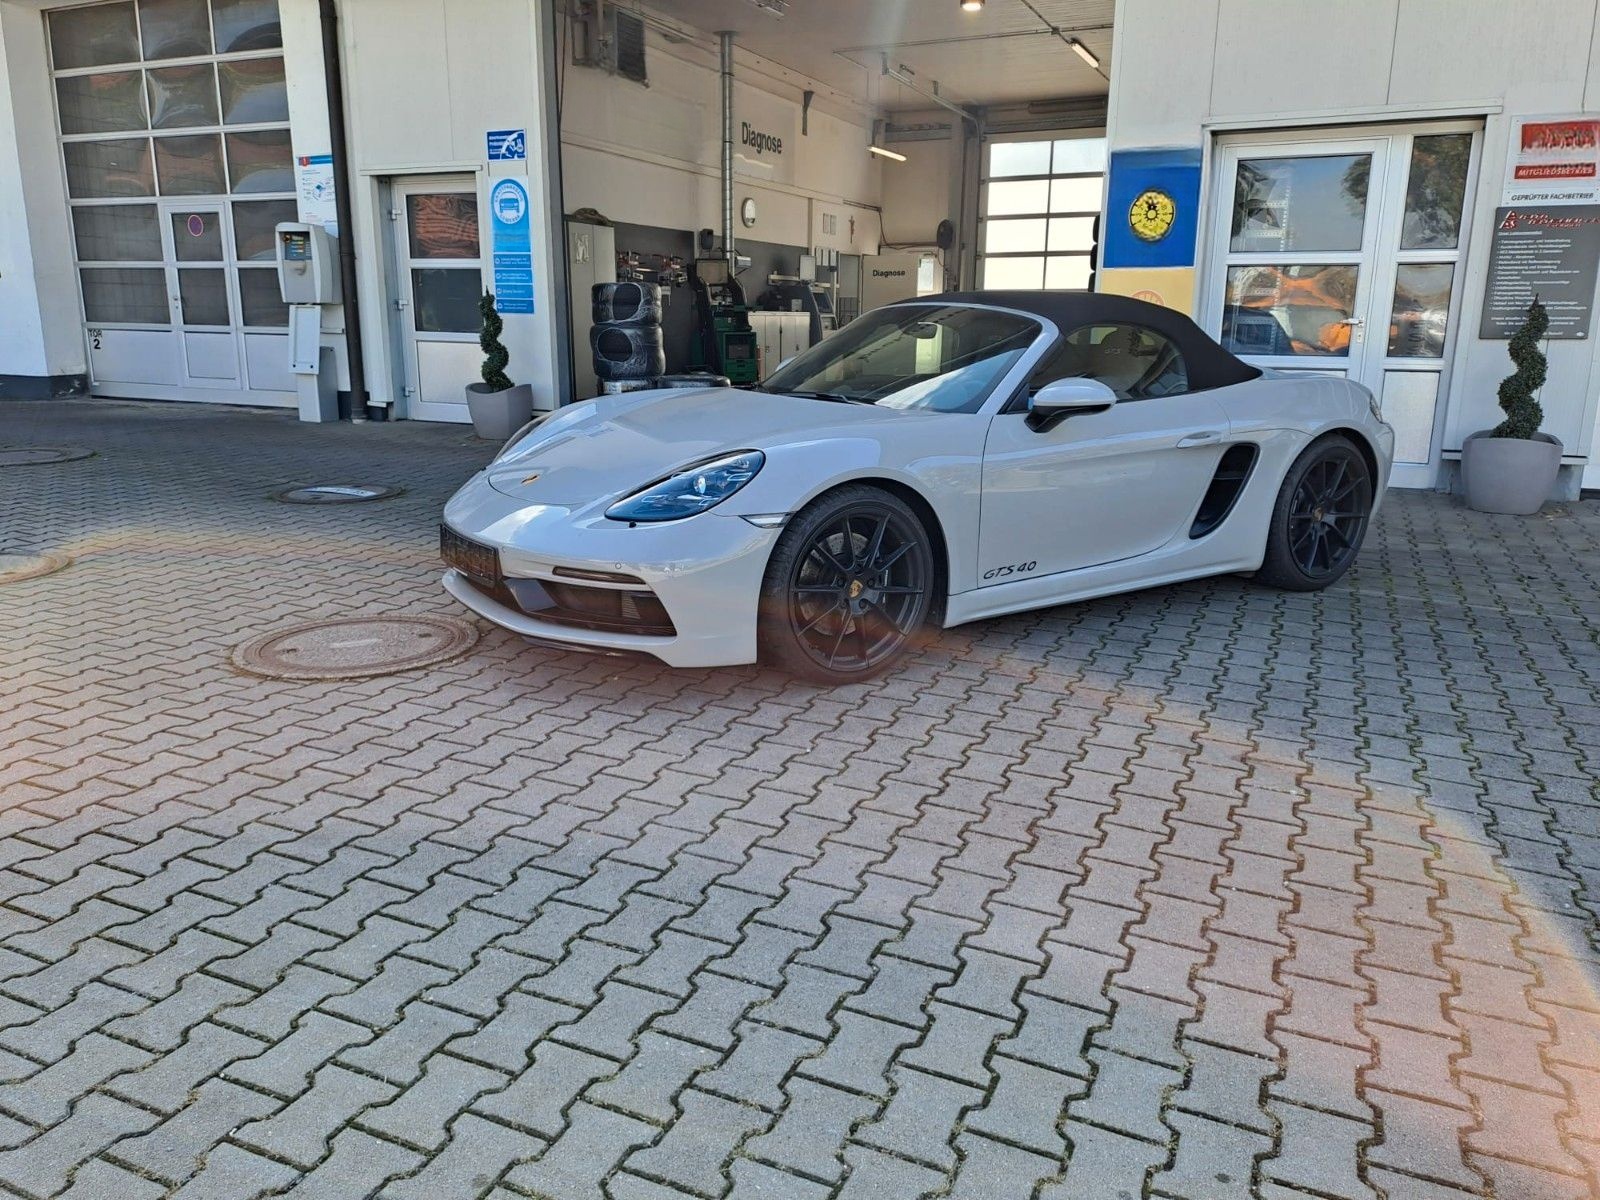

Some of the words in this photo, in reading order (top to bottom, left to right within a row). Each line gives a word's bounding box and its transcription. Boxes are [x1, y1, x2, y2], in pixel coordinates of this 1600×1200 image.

[742, 121, 782, 154] Diagnose
[1511, 193, 1548, 201] GEPRÜFTER
[1549, 192, 1594, 200] FACHBETRIEB
[873, 269, 906, 278] Diagnose
[88, 328, 103, 338] TOR
[93, 338, 102, 350] 2
[983, 565, 1016, 580] GTS
